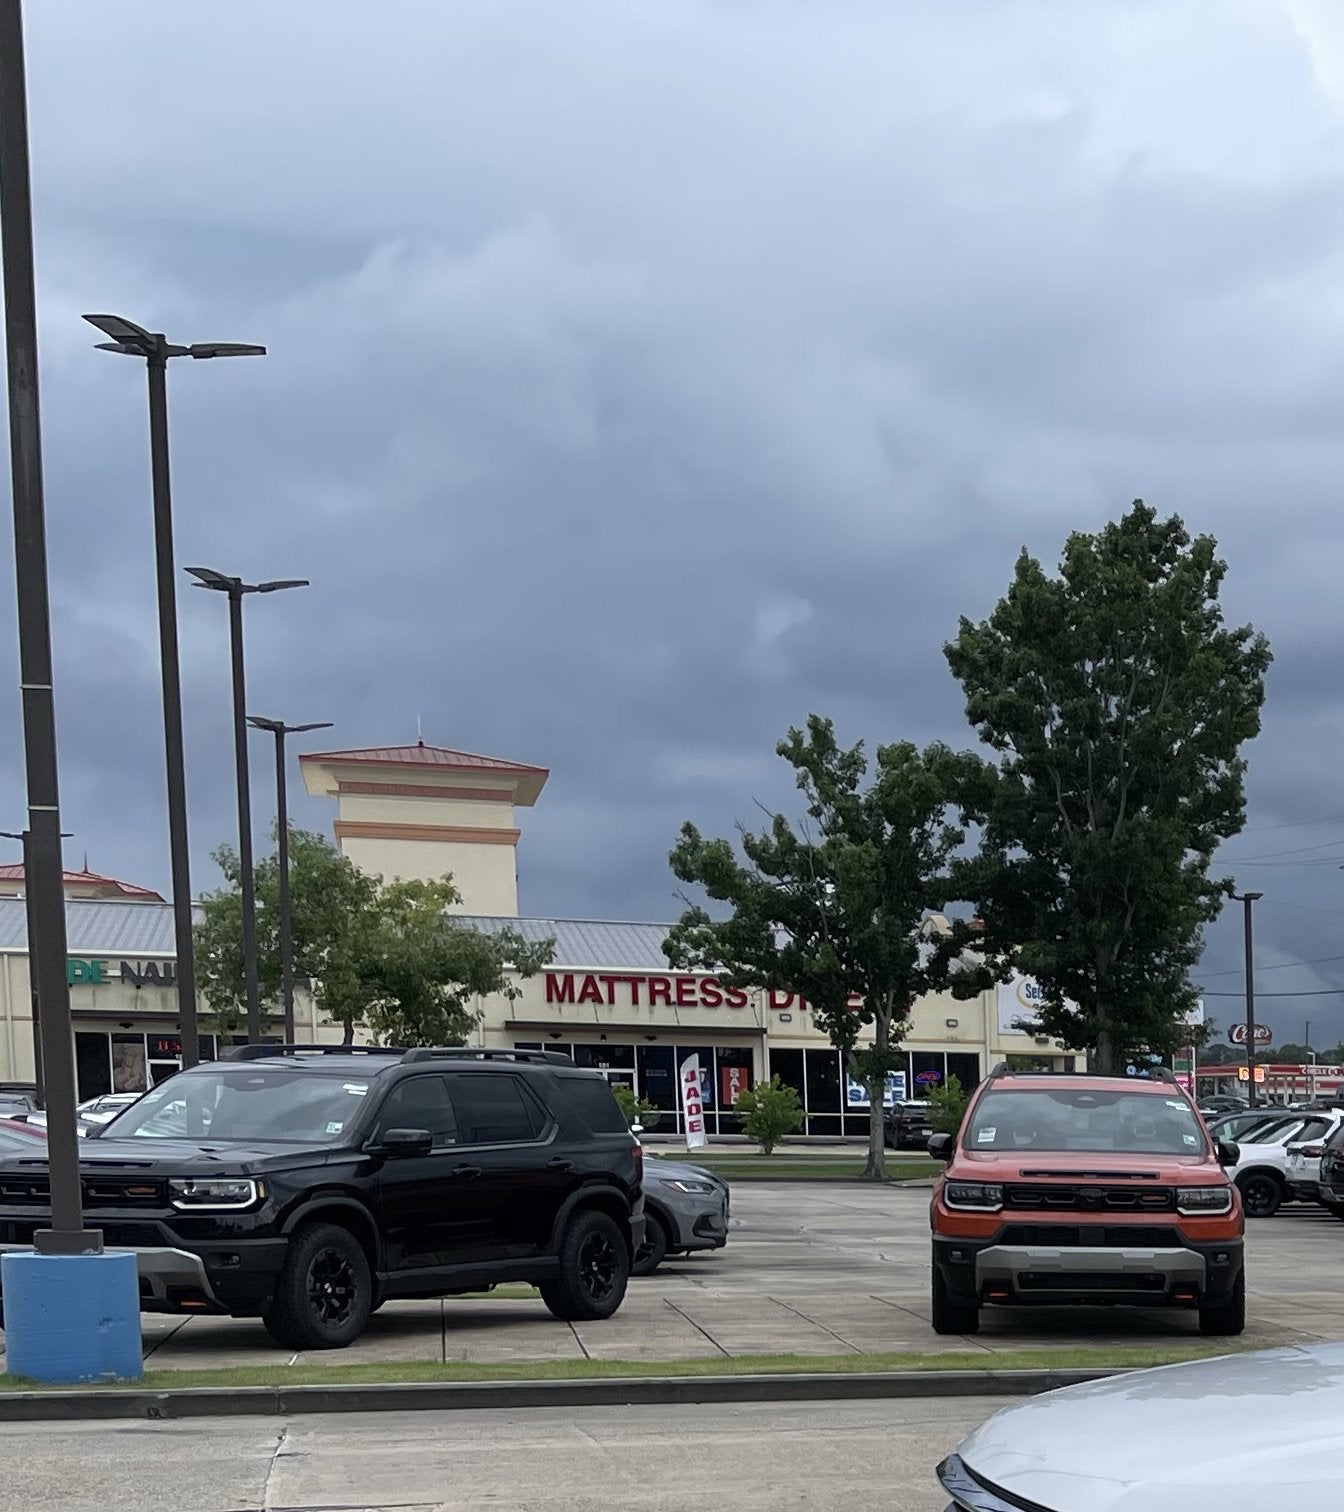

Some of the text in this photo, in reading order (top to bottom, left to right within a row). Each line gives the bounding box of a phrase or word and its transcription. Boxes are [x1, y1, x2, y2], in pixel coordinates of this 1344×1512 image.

[545, 973, 749, 1009] MATTRESS
[685, 1070, 703, 1133] JADE
[729, 1067, 741, 1105] SALE
